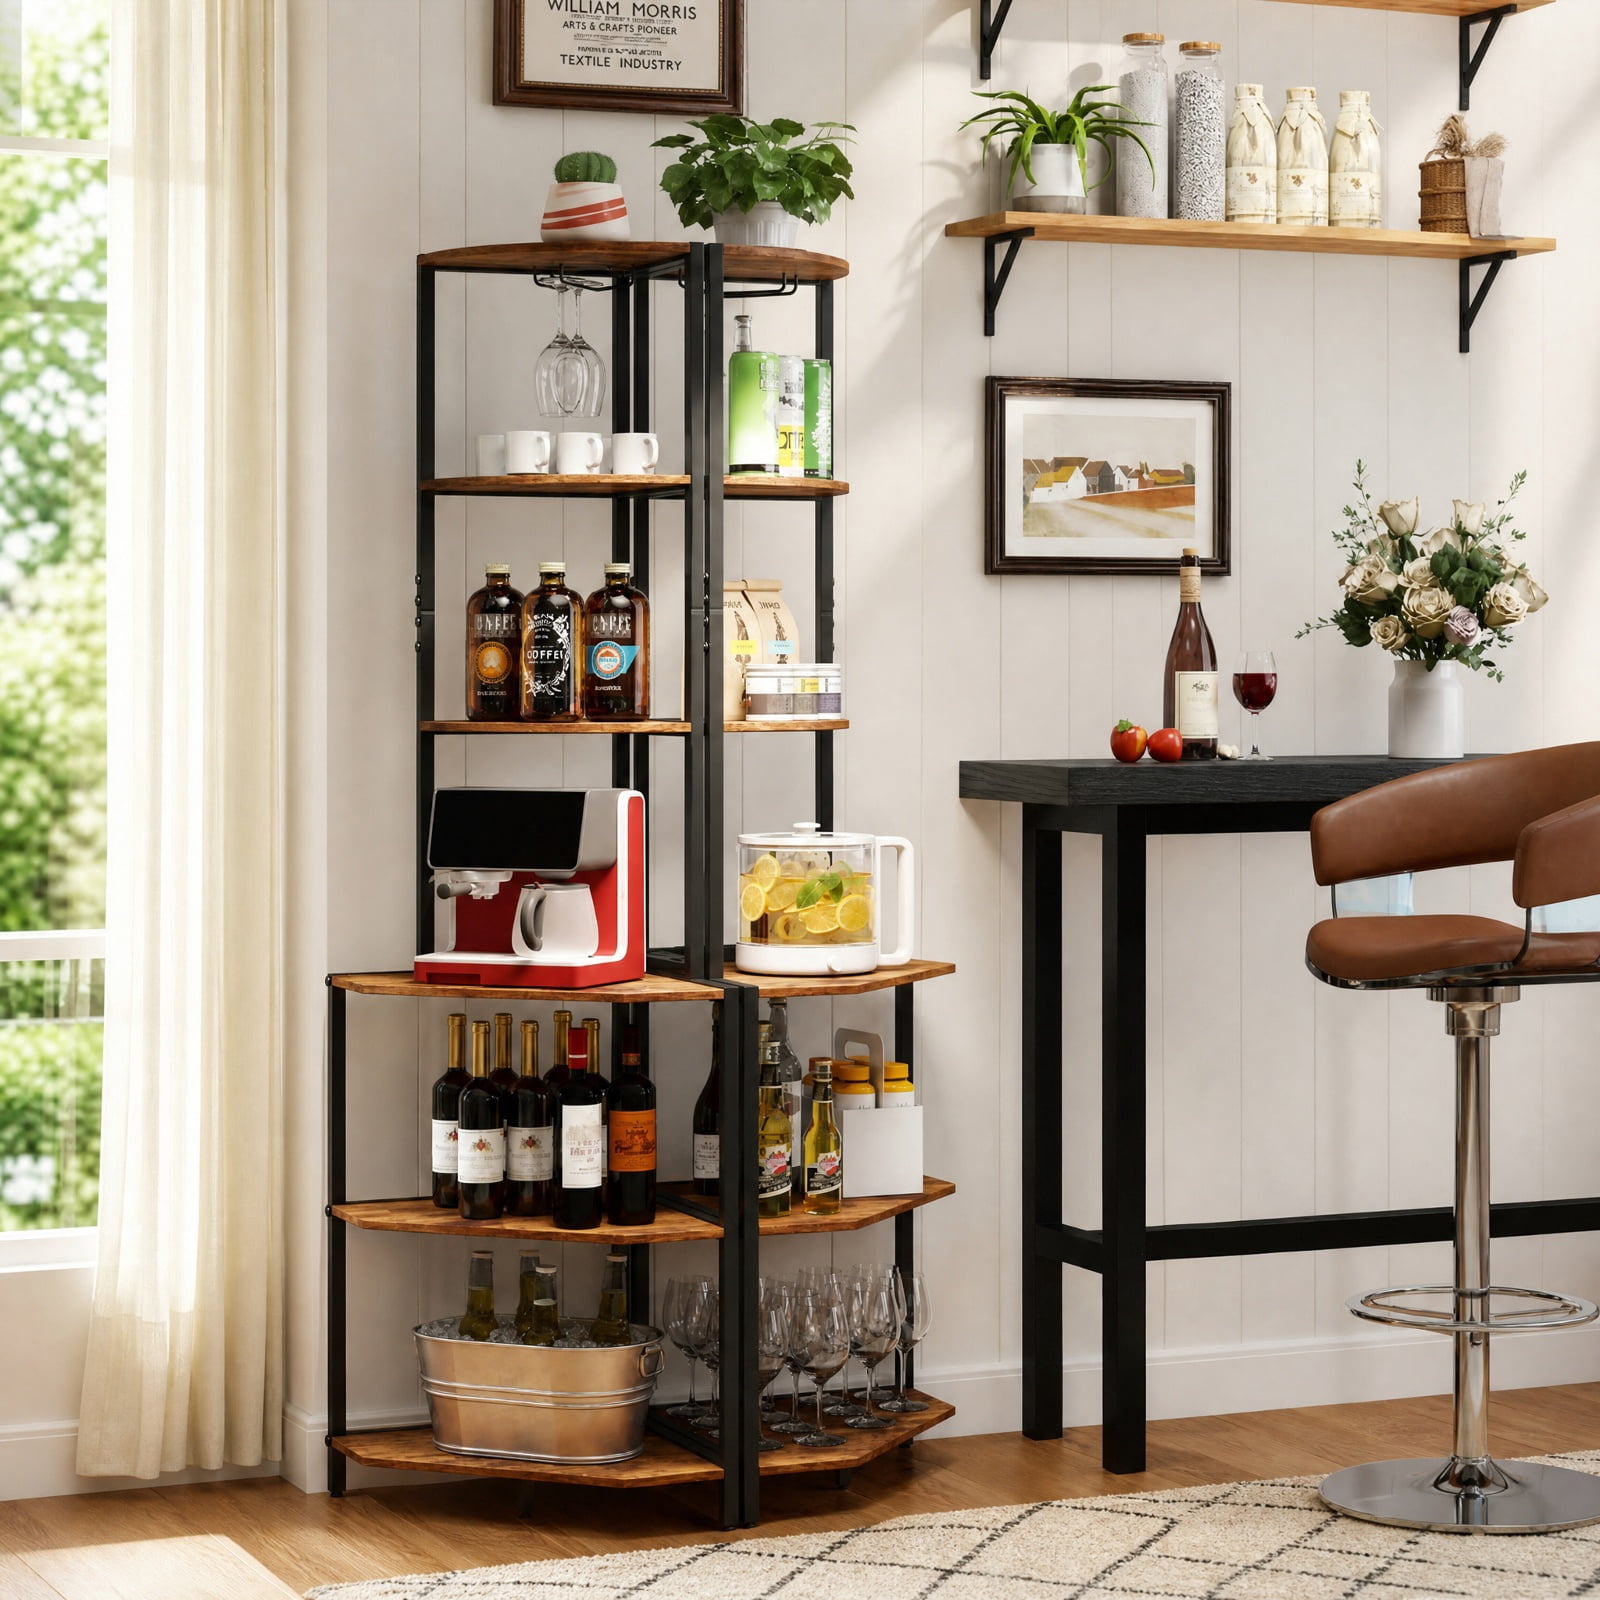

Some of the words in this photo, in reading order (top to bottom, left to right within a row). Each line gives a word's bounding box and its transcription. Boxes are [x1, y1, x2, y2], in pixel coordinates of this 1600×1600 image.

[548, 0, 619, 15] WILLIAM
[632, 3, 697, 20] MORRIS
[562, 21, 587, 30] ARTS
[589, 22, 596, 31] &
[599, 23, 635, 33] CRAFTS
[637, 25, 678, 35] PIONEER
[560, 54, 611, 67] TEXTILE
[620, 58, 682, 71] INDUSTRY
